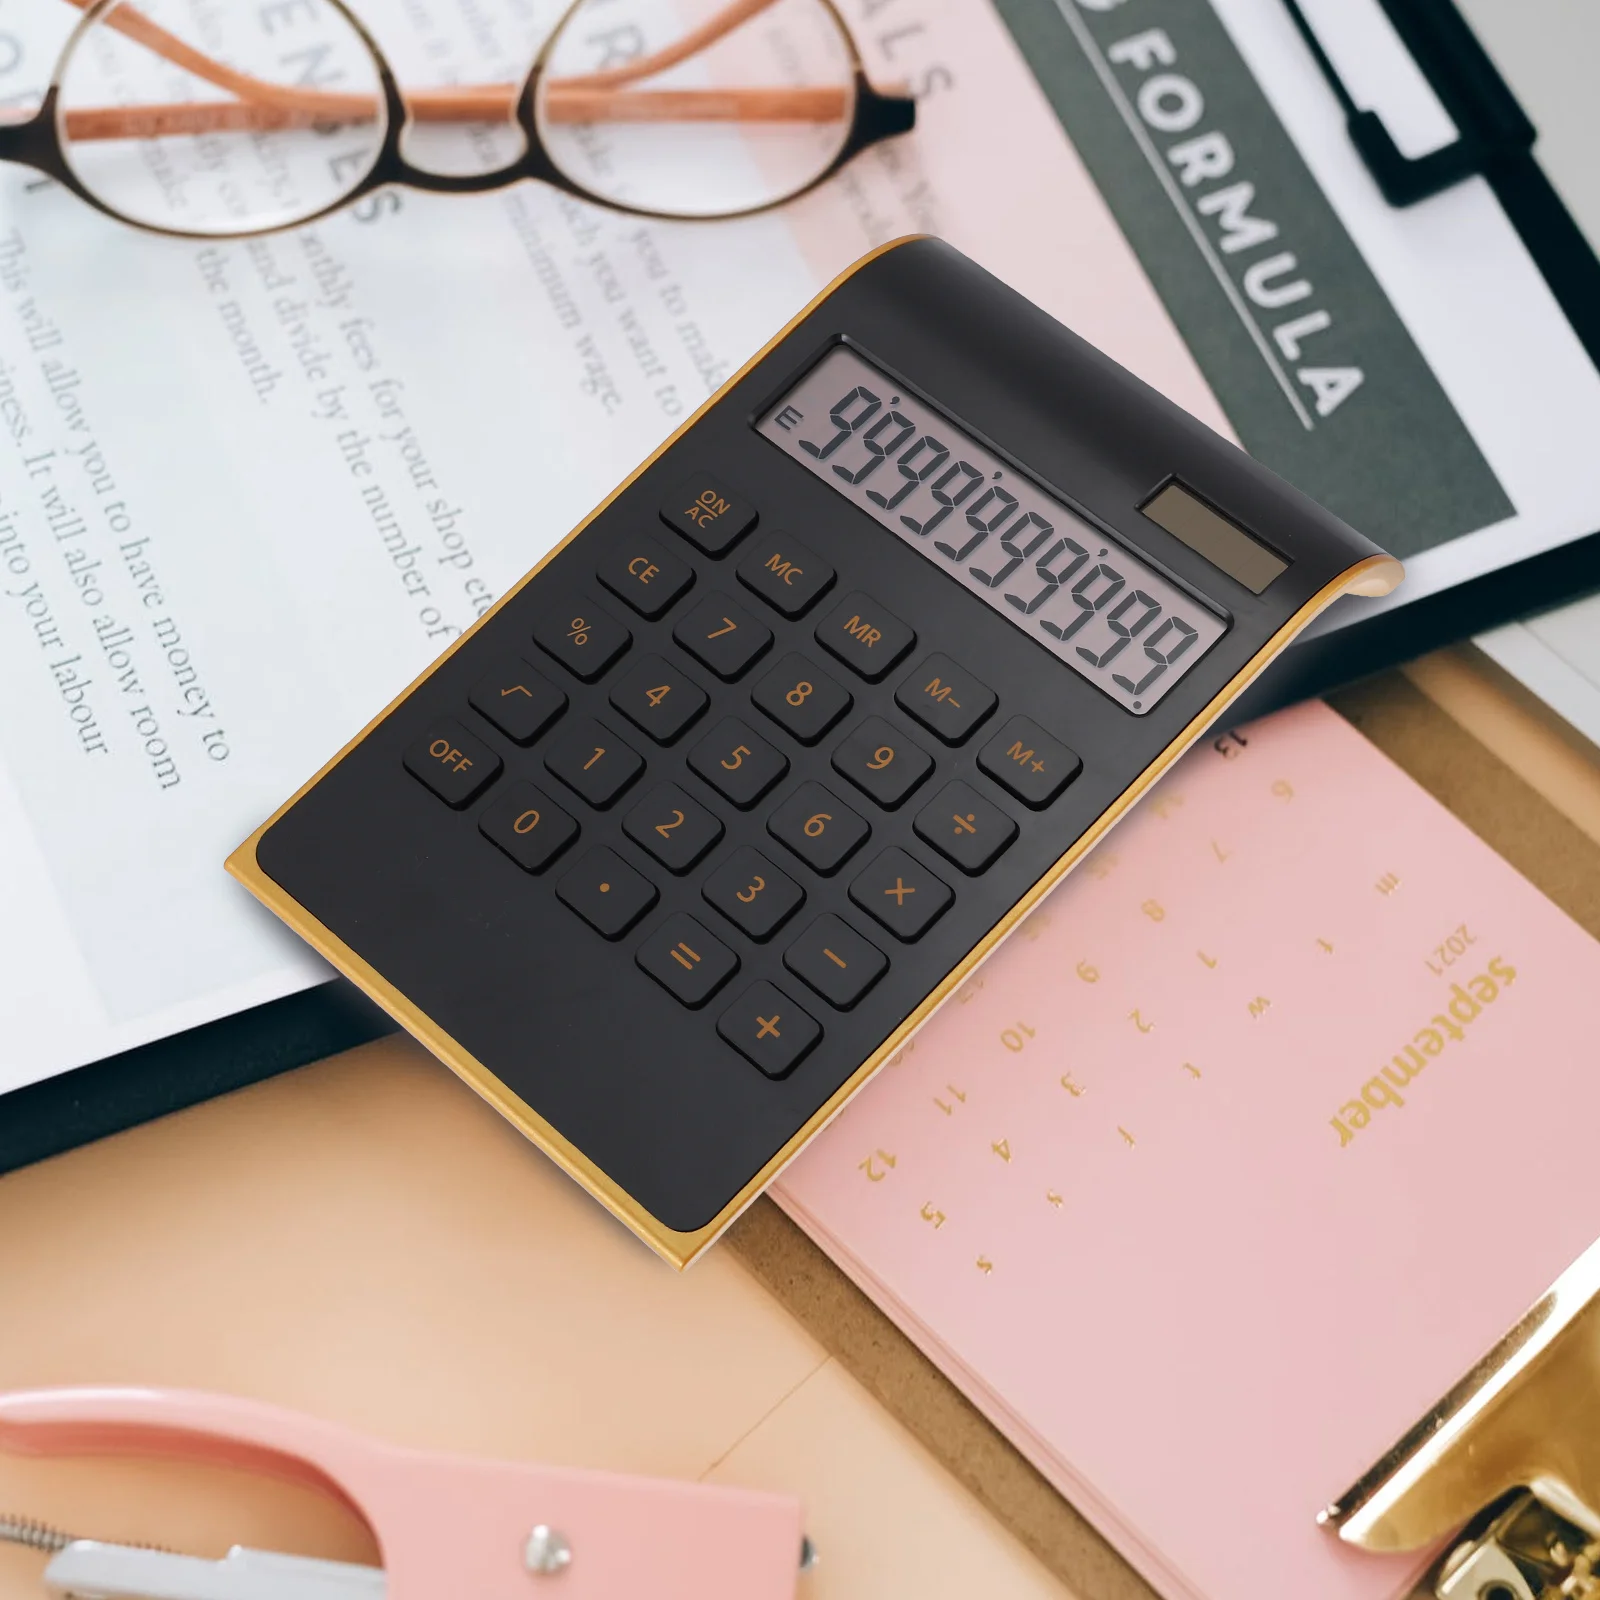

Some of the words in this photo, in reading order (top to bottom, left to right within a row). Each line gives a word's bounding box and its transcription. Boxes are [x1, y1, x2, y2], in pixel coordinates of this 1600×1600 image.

[1107, 26, 1365, 417] FORMULA
[17, 296, 64, 353] will
[194, 246, 232, 295] the
[216, 299, 284, 405] month.
[40, 358, 91, 433] allow
[367, 377, 405, 420] for
[23, 449, 57, 480] It
[63, 438, 117, 495] you
[378, 424, 438, 490] your
[40, 484, 88, 543] will
[103, 500, 132, 533] to
[309, 384, 351, 422] by
[336, 428, 373, 478] the
[361, 484, 432, 598] number
[418, 604, 463, 638] of
[684, 505, 714, 529] AC
[698, 488, 732, 515] ON
[424, 498, 474, 572] shop
[63, 547, 104, 608] also
[119, 536, 165, 609] have
[627, 556, 660, 584] CE
[764, 553, 803, 586] MC
[566, 616, 592, 646] %
[706, 617, 737, 640] 7
[842, 615, 882, 648] MR
[5, 581, 65, 650] your
[48, 654, 109, 754] labour
[91, 613, 145, 694] allow
[152, 616, 216, 718] money
[645, 685, 671, 708] 4
[785, 680, 814, 707] 8
[129, 704, 182, 791] room
[202, 728, 231, 762] to
[428, 738, 474, 774] OFF
[583, 746, 606, 771] 1
[720, 745, 752, 771] 5
[865, 745, 895, 770] 9
[1006, 740, 1046, 774] M+
[1213, 730, 1249, 762] 13
[512, 809, 541, 835] 0
[655, 809, 685, 839] 2
[803, 813, 833, 838] 6
[735, 875, 766, 904] 3
[1424, 922, 1478, 977] 2021
[1126, 1006, 1155, 1035] 2
[999, 1021, 1038, 1054] 10
[1328, 954, 1518, 1149] september
[1059, 1071, 1087, 1099] 3
[857, 1147, 898, 1183] 12
[990, 1138, 1014, 1165] 4
[919, 1201, 948, 1231] 5
